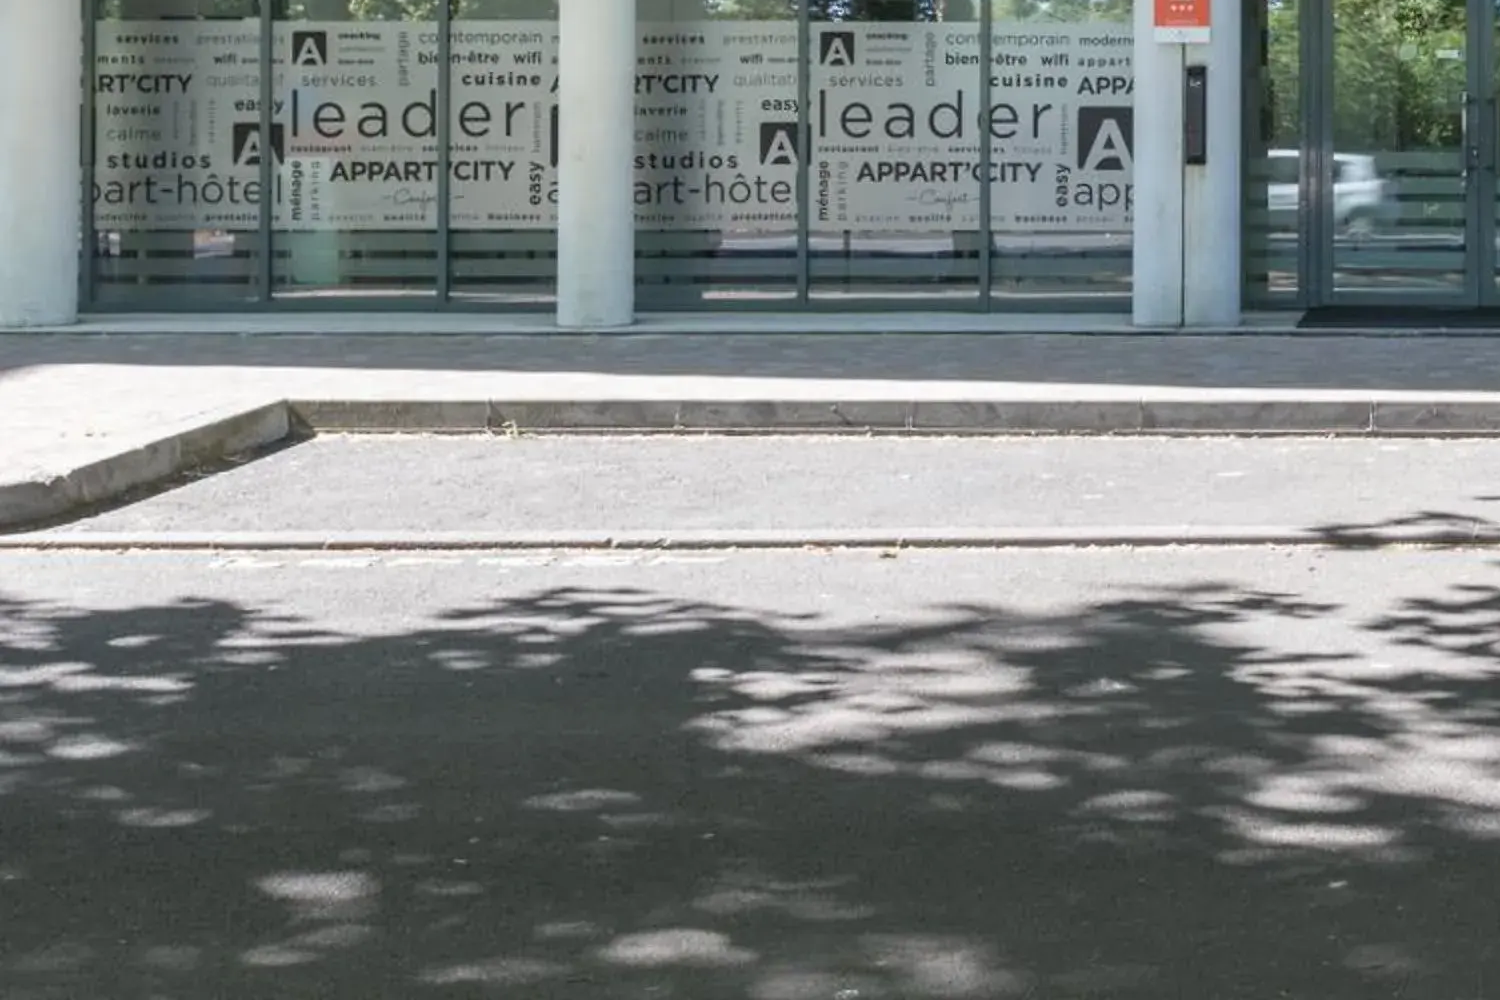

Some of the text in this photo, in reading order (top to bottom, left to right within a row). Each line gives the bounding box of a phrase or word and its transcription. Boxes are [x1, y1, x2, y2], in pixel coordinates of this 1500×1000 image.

[945, 32, 1071, 47] conemporain
[213, 53, 237, 65] wifi
[513, 50, 542, 65] wifi
[1040, 52, 1069, 67] wifi
[94, 73, 193, 95] RT'CITY
[302, 72, 376, 87] services
[461, 72, 542, 87] cuisine
[828, 73, 904, 88] services
[990, 73, 1068, 88] cuisine
[290, 88, 525, 138] leader
[818, 88, 1053, 139] leader
[107, 150, 212, 169] studios
[634, 151, 737, 169] studios
[330, 160, 516, 183] APPART'CITY
[856, 161, 1043, 183] APPART'CITY
[527, 161, 546, 206] easy
[634, 173, 791, 205] art-hôte
[1055, 163, 1072, 207] easy
